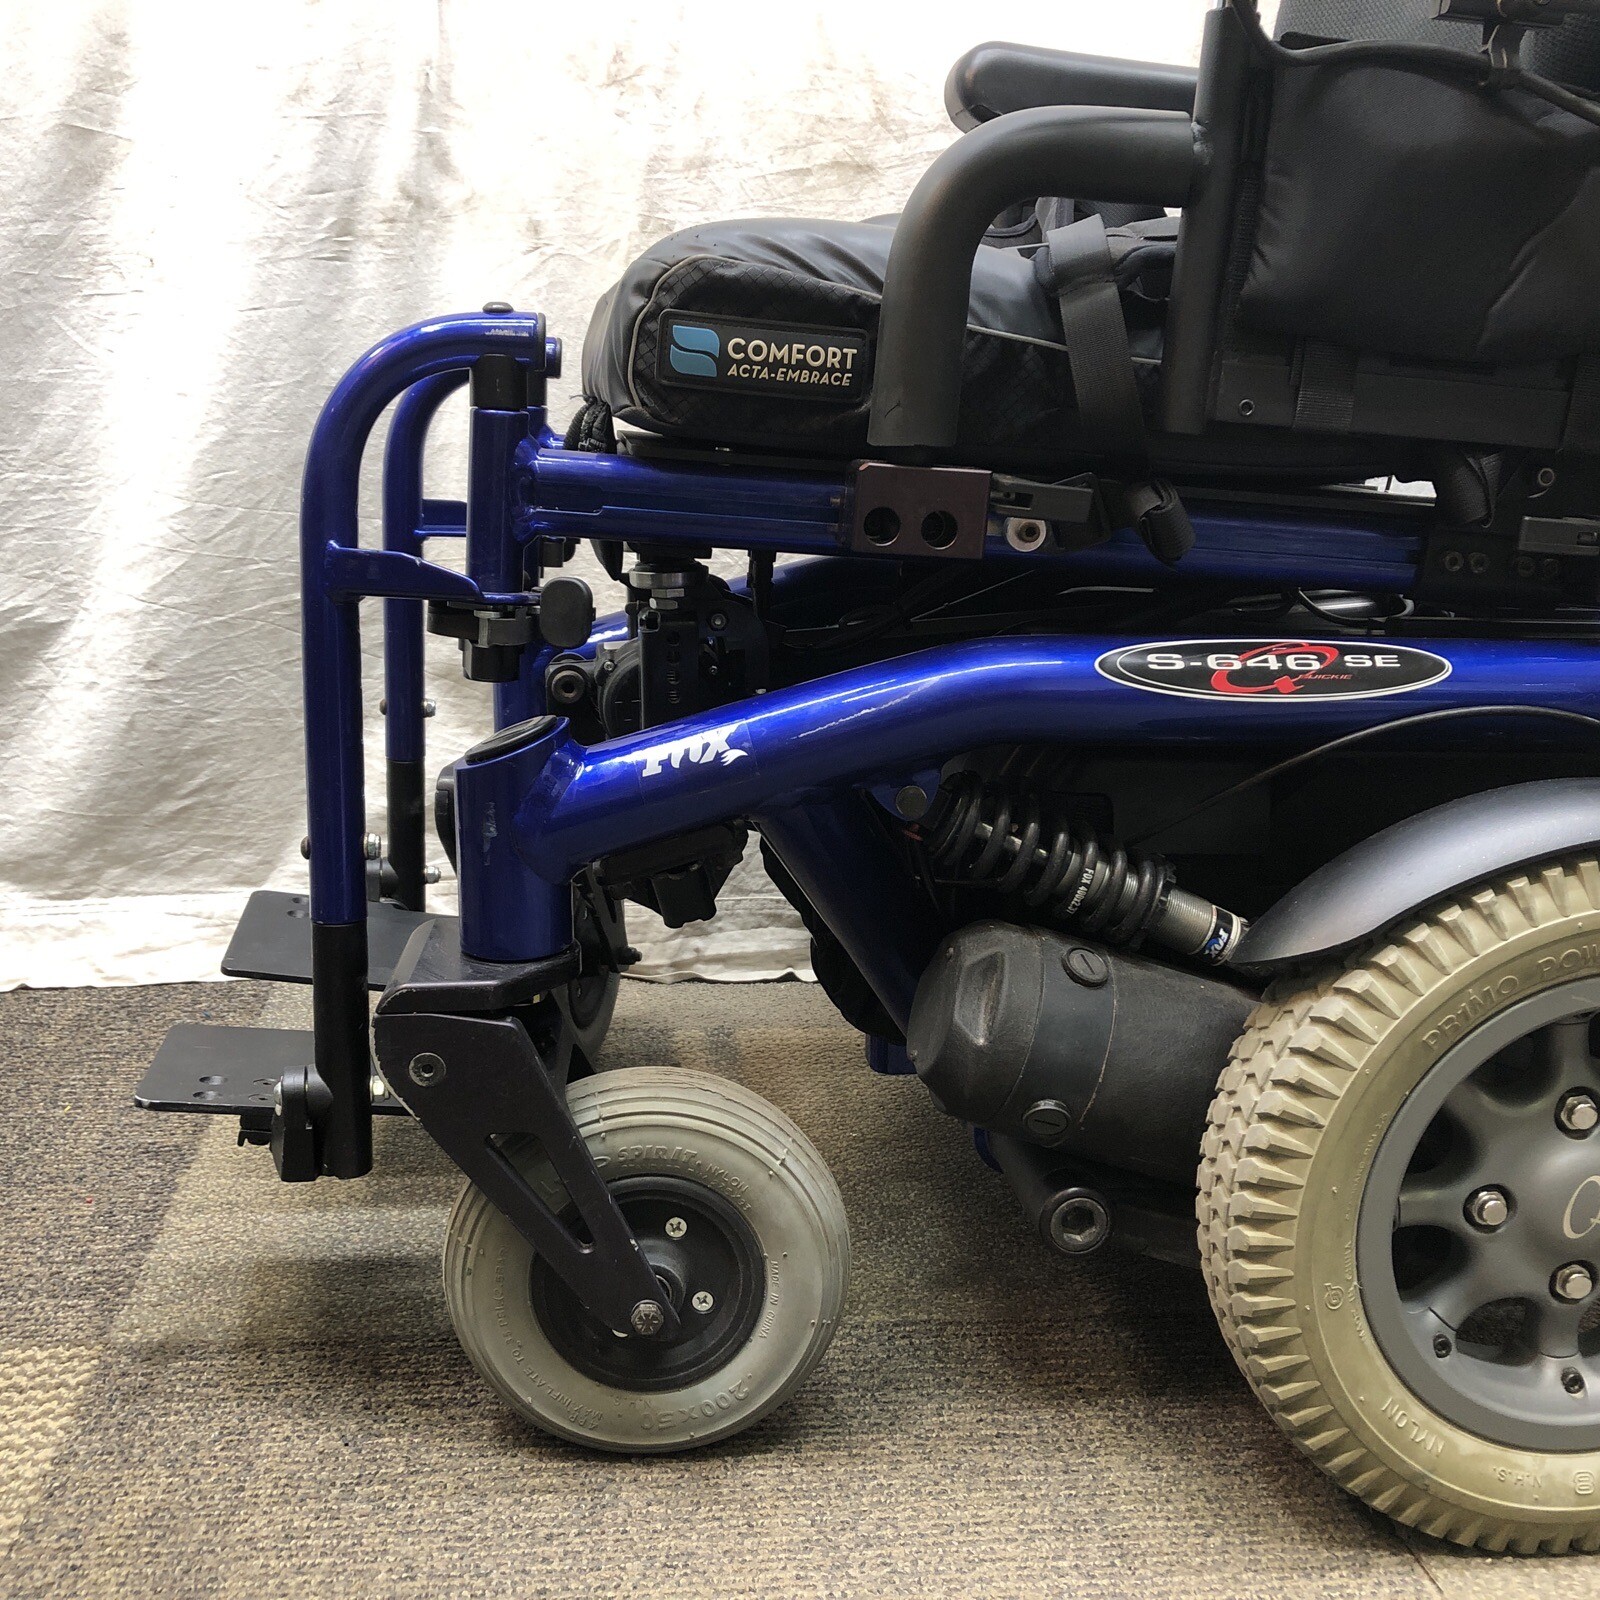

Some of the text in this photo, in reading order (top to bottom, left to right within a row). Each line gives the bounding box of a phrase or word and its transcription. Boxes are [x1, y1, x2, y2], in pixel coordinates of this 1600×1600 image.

[727, 337, 858, 370] COMFORT
[727, 363, 853, 387] ACTA-EMBRACE
[1146, 653, 1402, 671] S-646 SE
[1080, 868, 1095, 885] FOX
[617, 1144, 698, 1165] SPIRIT
[705, 1162, 749, 1193] NYLON
[758, 1309, 776, 1340] CHINA
[1380, 1396, 1446, 1456] NYLON
